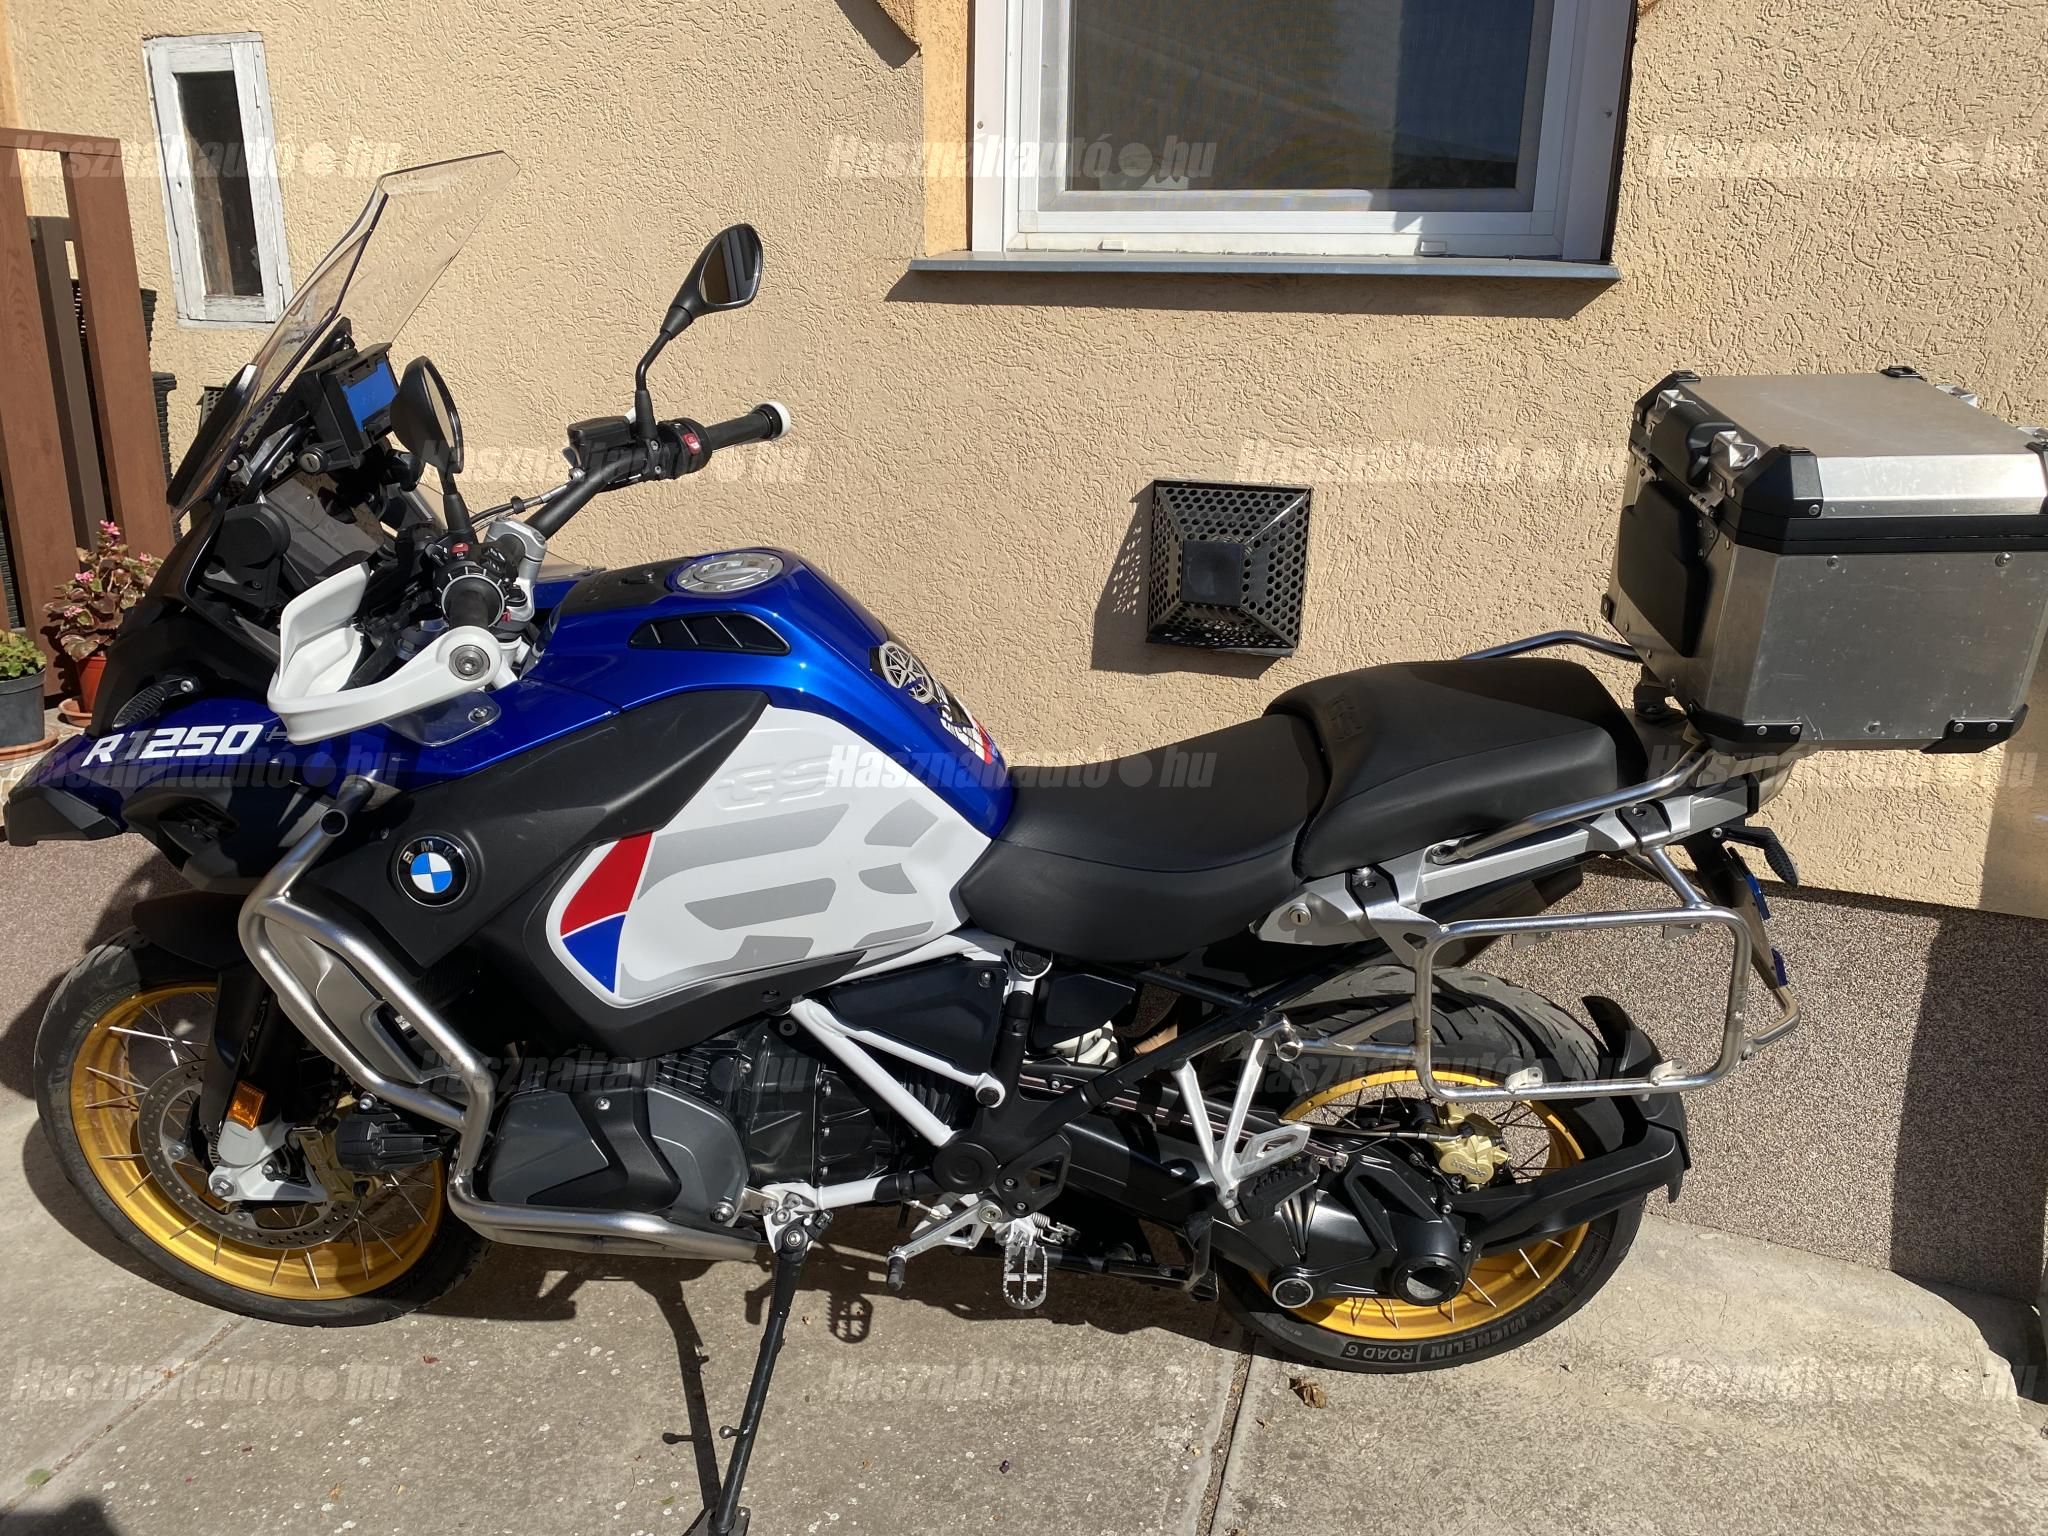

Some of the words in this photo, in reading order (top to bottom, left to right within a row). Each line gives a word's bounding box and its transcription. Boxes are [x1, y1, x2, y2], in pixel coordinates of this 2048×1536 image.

[402, 840, 459, 865] BMW
[1429, 1313, 1529, 1360] MICHELIN
[1345, 1344, 1359, 1357] 6
[1363, 1344, 1417, 1362] ROAD
